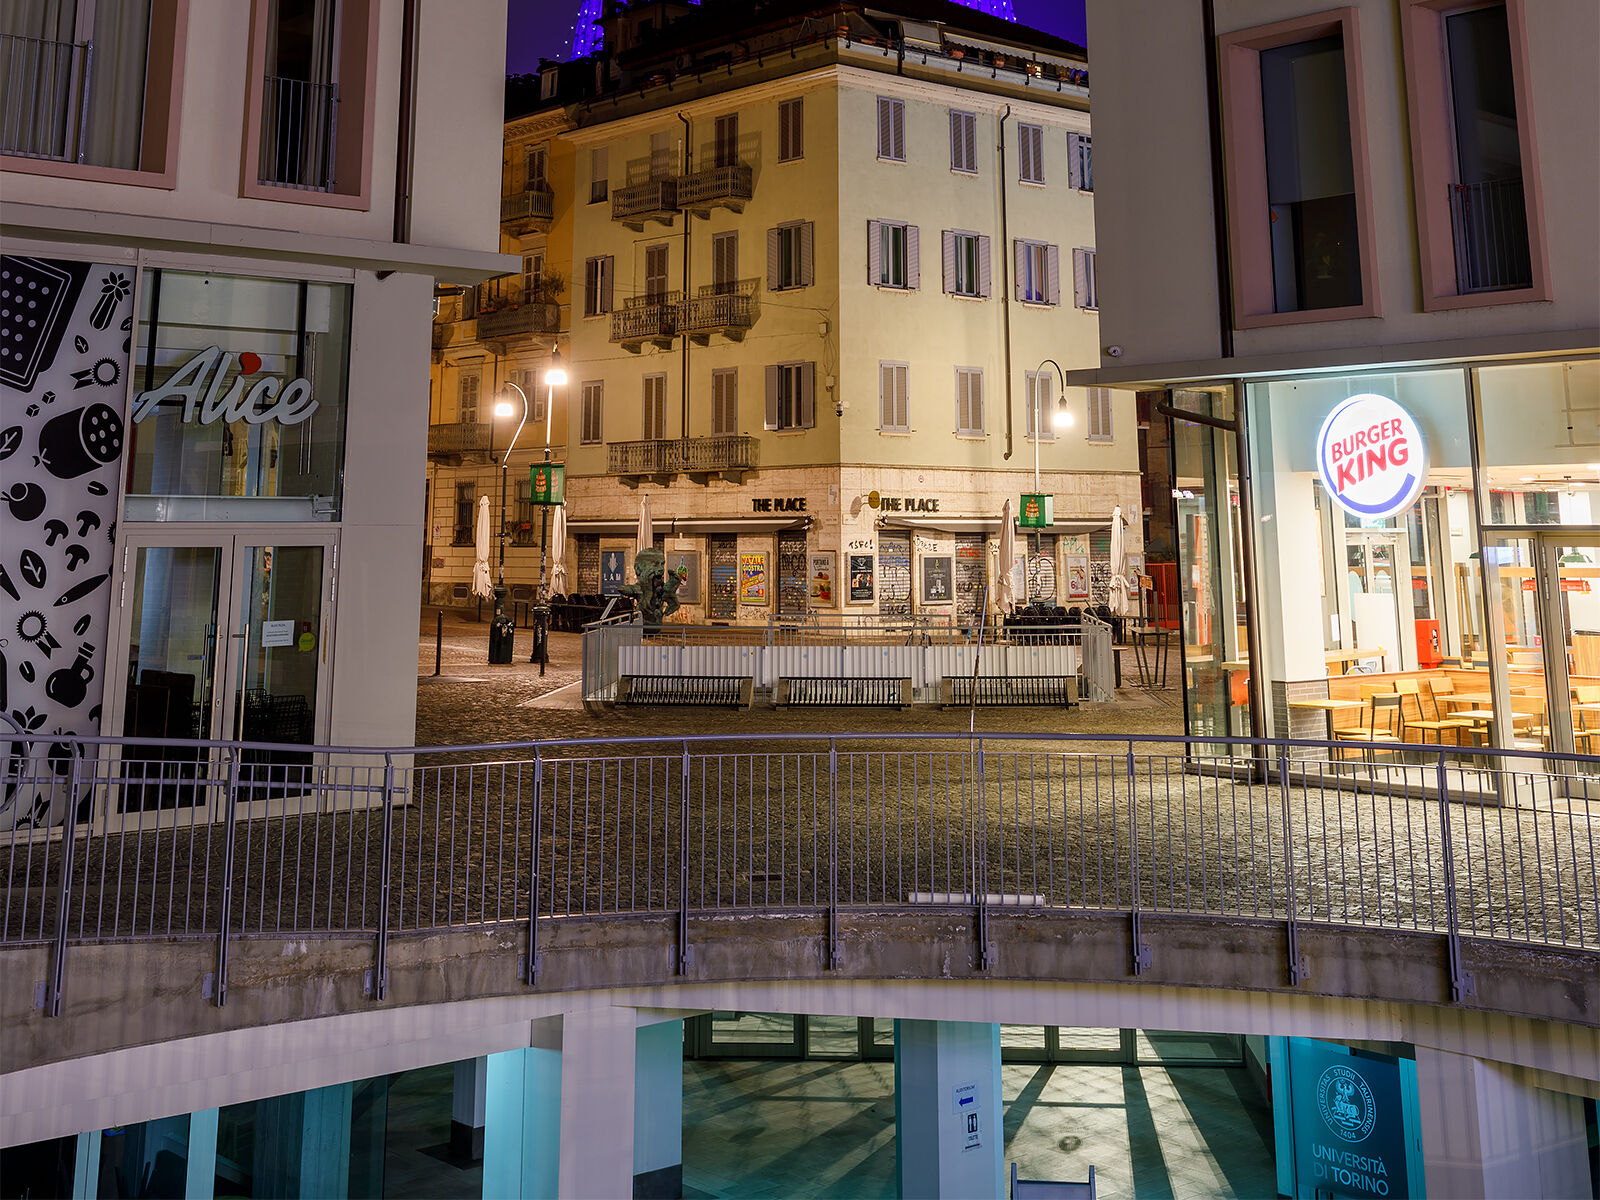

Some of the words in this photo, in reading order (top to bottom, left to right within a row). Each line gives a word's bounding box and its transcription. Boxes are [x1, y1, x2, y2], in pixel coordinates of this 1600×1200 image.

[133, 345, 320, 425] Alice
[1331, 418, 1403, 464] BURGER
[1336, 437, 1409, 493] KING
[752, 498, 772, 512] THE
[774, 497, 807, 512] PLACE
[880, 497, 902, 512] THE
[904, 498, 940, 513] PLACE
[741, 556, 764, 564] NATALE
[742, 563, 764, 572] GIOSTRA
[1333, 1068, 1356, 1081] STUDII
[1320, 1075, 1333, 1126] UNIVERSITAS
[1360, 1083, 1374, 1134] TAURINENSIS
[1340, 1128, 1357, 1139] 1404
[1312, 1143, 1387, 1176] UNIVERSITÀ
[1313, 1161, 1328, 1179] DI
[1331, 1165, 1389, 1196] TORINO
